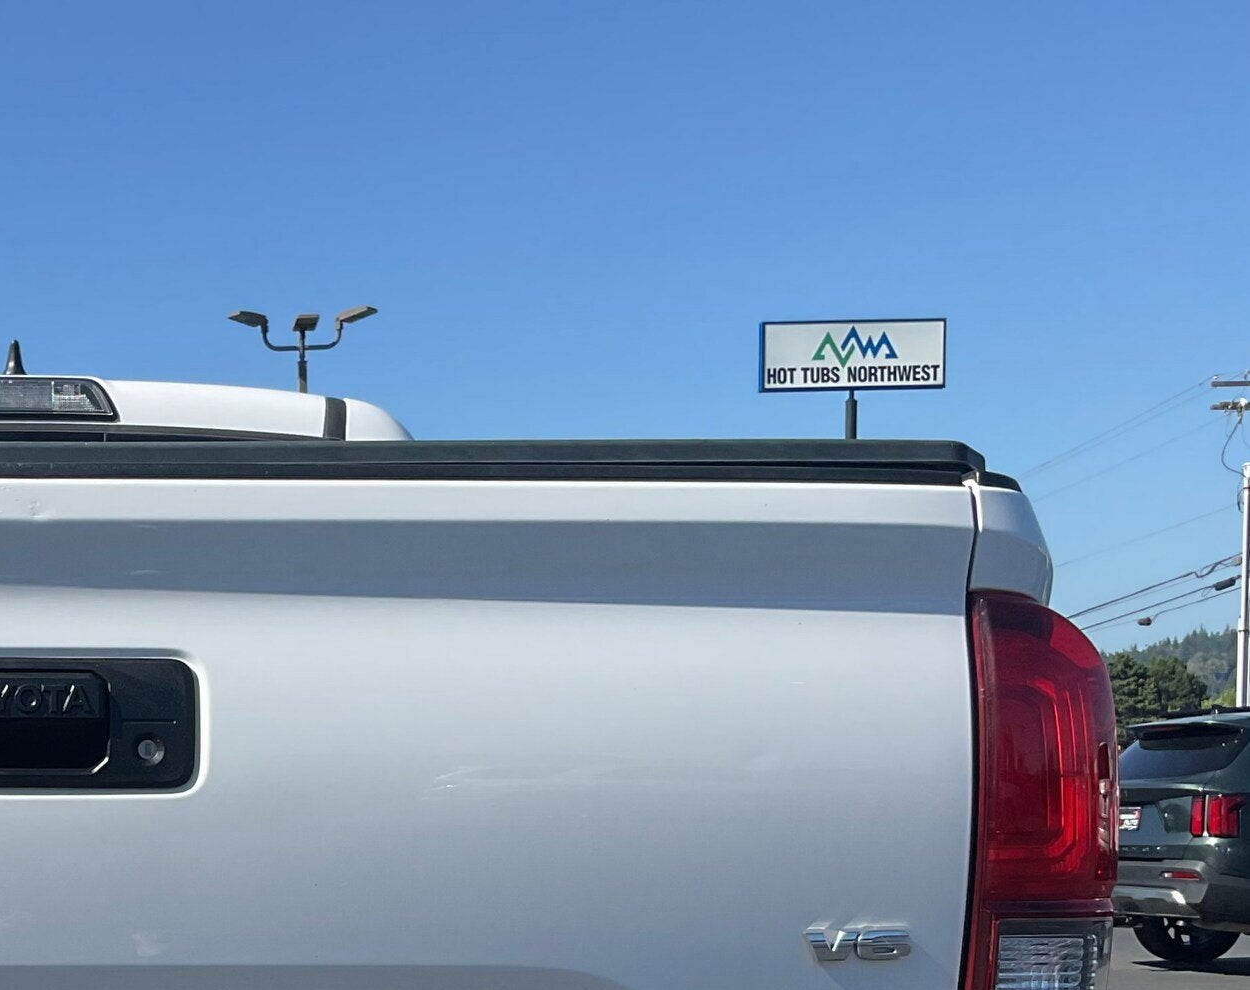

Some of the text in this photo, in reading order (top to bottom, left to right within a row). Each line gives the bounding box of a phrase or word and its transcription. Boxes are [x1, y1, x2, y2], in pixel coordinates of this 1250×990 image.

[767, 364, 940, 384] HOT TUBS NORTHWEST
[803, 922, 912, 962] V6
